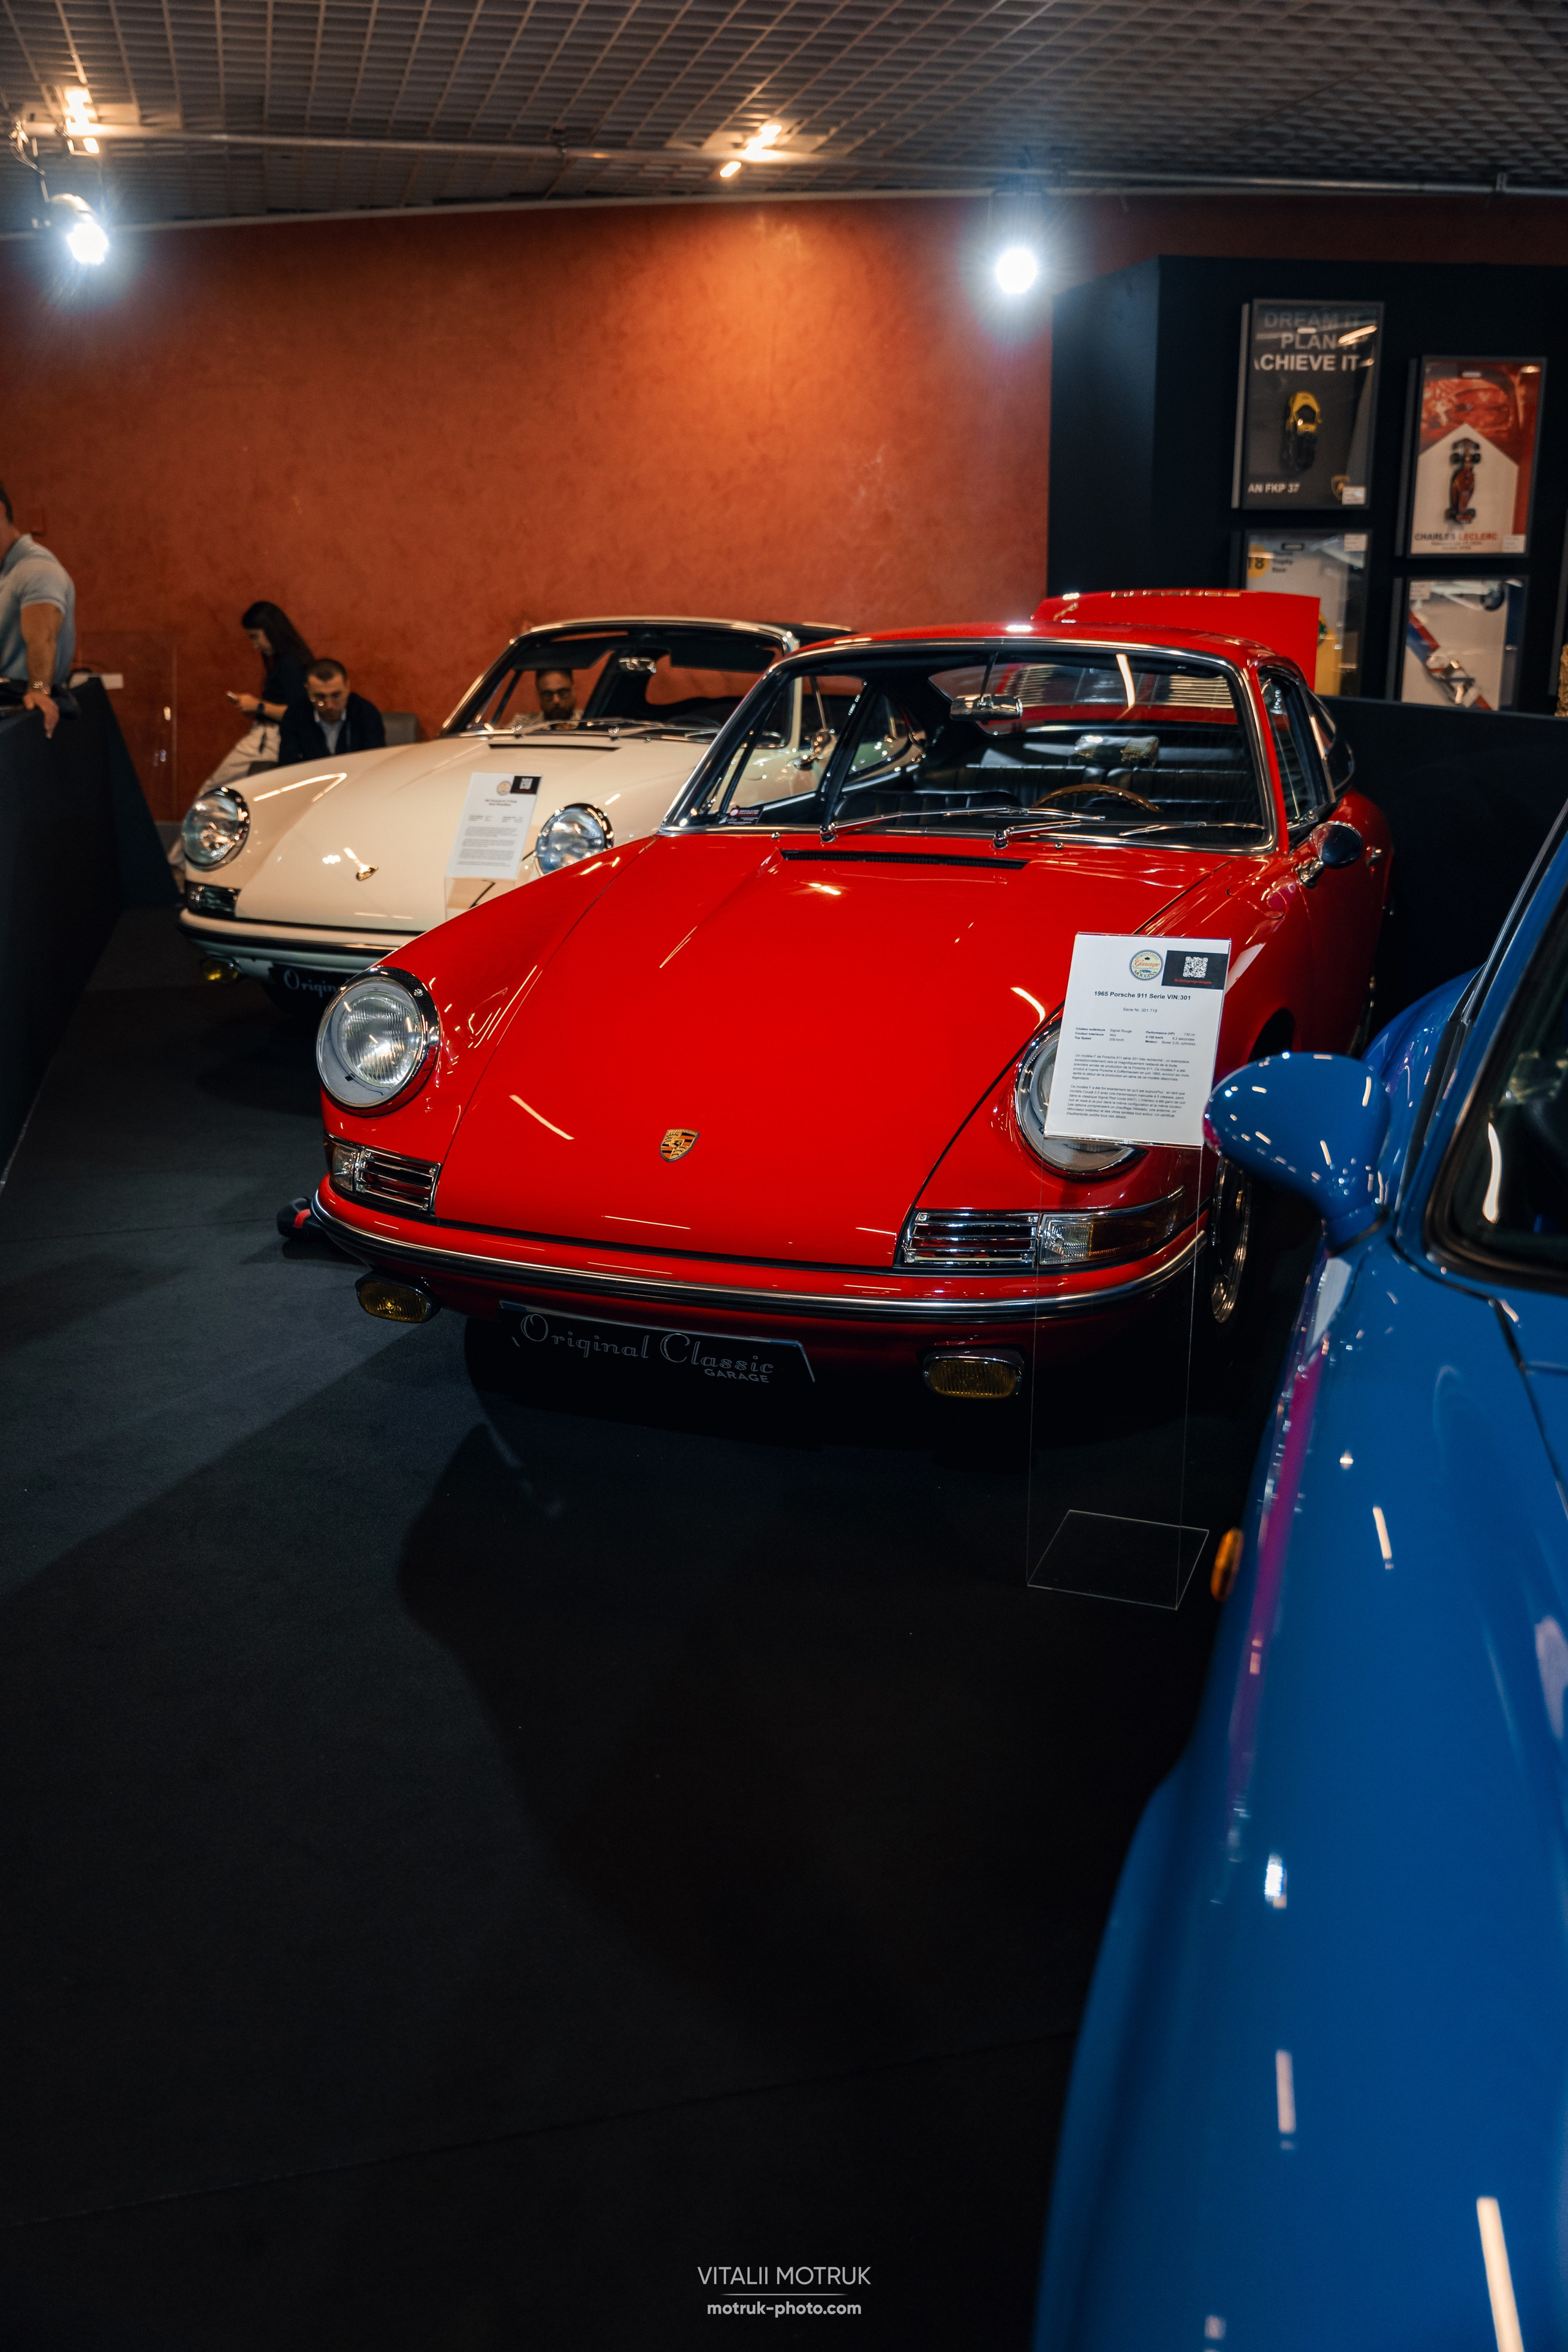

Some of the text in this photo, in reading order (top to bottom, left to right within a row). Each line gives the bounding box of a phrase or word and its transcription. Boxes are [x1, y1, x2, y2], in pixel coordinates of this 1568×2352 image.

[1281, 333, 1336, 350] PLAN
[1341, 354, 1359, 371] IT
[520, 1313, 774, 1374] Original Classic
[704, 1368, 770, 1383] GARAGE
